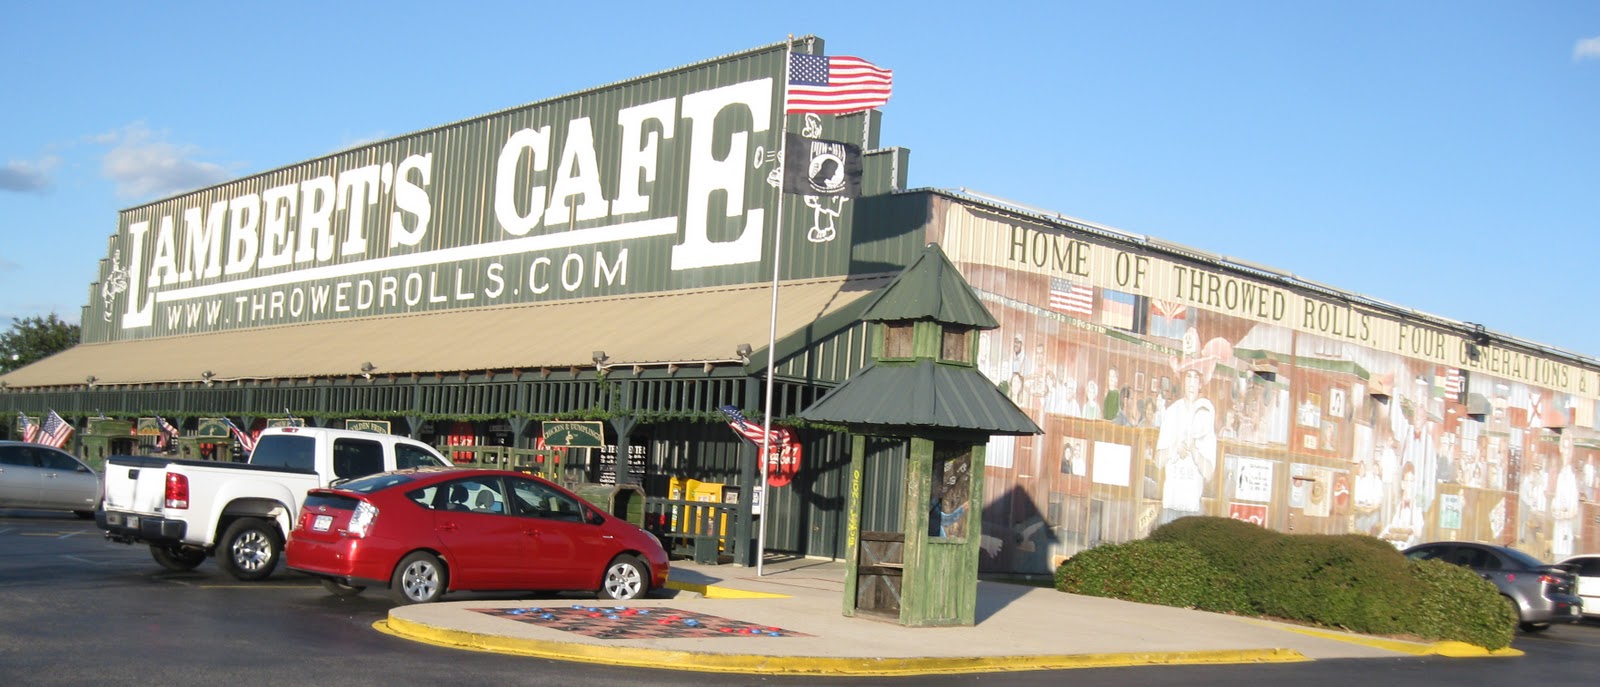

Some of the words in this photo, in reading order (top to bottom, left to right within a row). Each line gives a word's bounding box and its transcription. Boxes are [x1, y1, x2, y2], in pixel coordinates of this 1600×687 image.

[122, 152, 433, 330] LAMBERT'S
[494, 77, 773, 271] CAFE
[1008, 225, 1090, 278] HOME
[1115, 251, 1150, 290] OF
[1173, 265, 1286, 321] THROWED
[1398, 323, 1446, 361] FOUR
[544, 424, 565, 439] CHICKEN
[571, 424, 602, 441] DUMPLINGS
[628, 445, 647, 455] ETER
